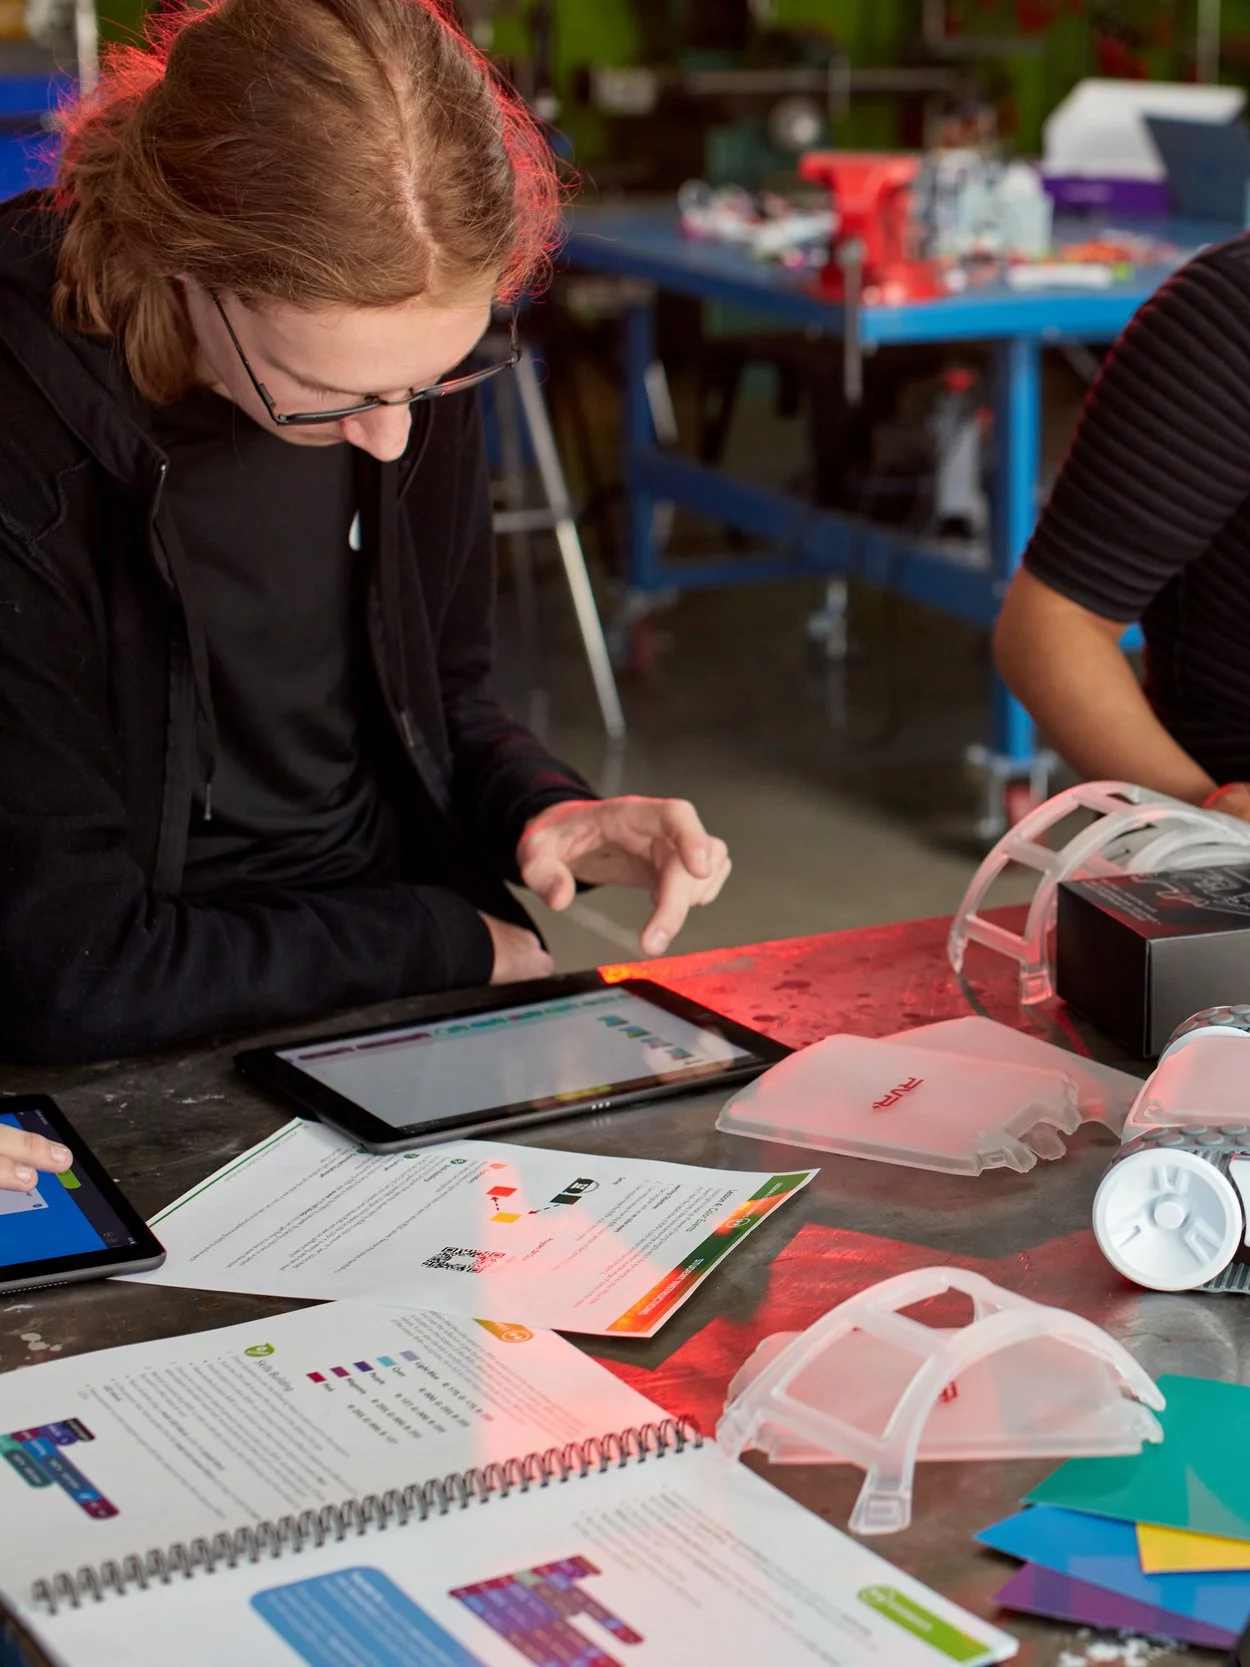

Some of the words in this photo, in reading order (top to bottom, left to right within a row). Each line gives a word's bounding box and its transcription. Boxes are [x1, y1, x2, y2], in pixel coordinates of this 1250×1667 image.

[718, 1190, 737, 1202] Lesson
[702, 1208, 718, 1218] Color
[686, 1219, 706, 1232] Events
[677, 1259, 703, 1279] STUDENT
[639, 1281, 679, 1314] INSTRUCTIONS
[255, 1360, 272, 1372] Skills
[269, 1372, 293, 1391] Building
